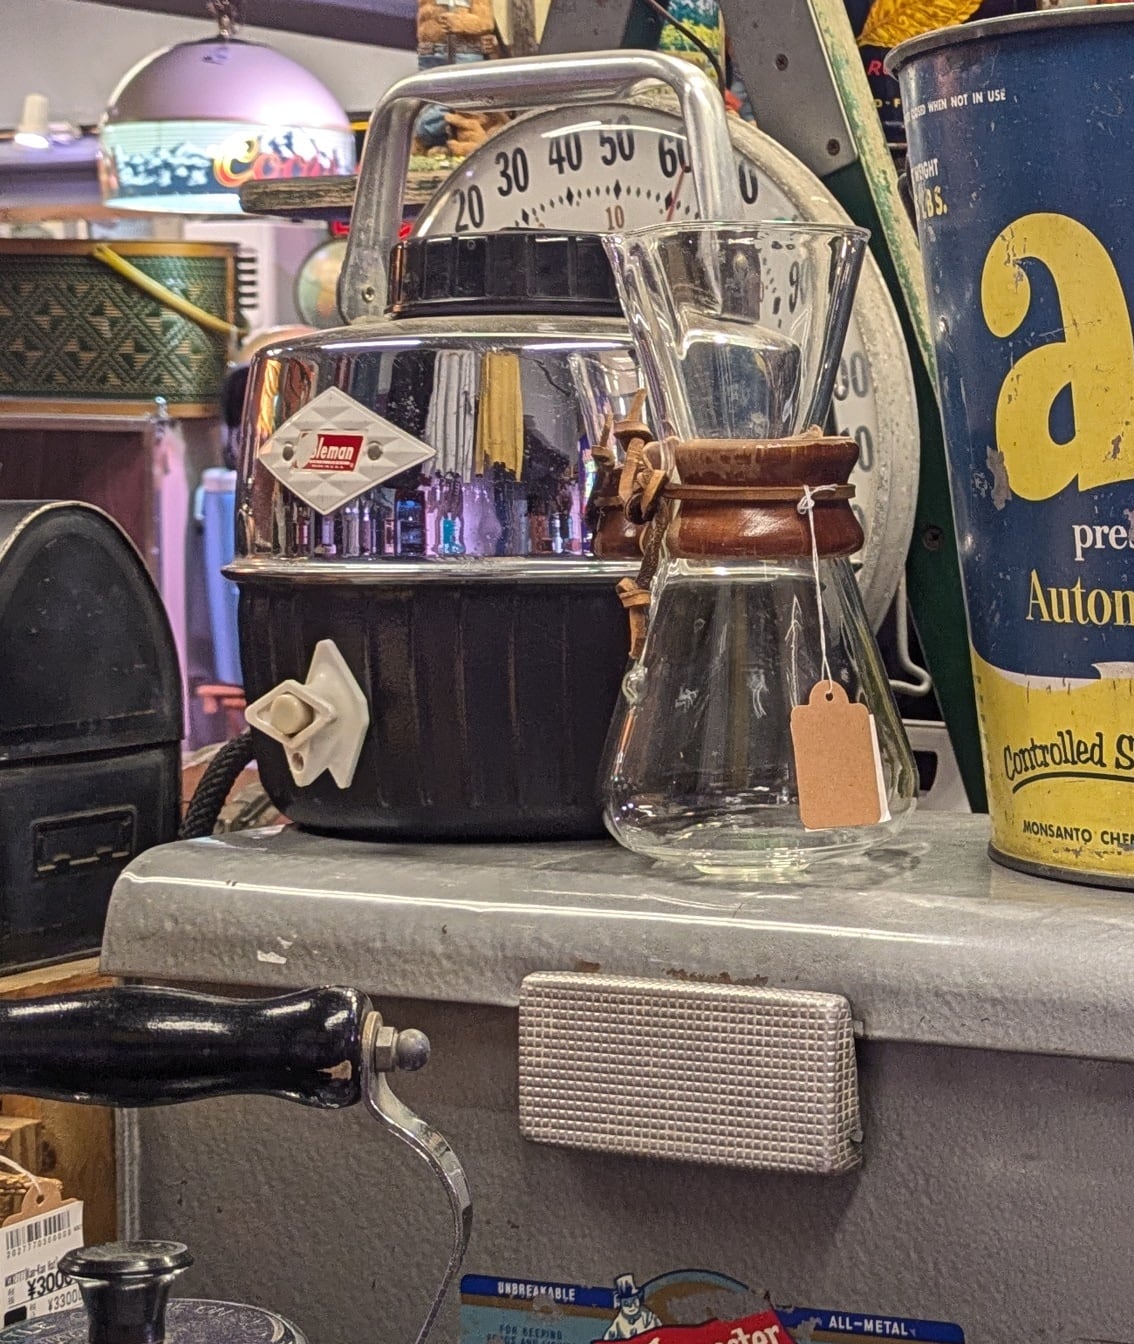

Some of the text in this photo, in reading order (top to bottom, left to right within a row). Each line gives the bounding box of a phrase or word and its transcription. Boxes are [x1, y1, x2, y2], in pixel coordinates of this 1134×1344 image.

[928, 98, 947, 113] WHEN
[951, 94, 968, 108] NOT
[972, 91, 983, 104] IN
[986, 88, 1006, 102] USE
[453, 184, 484, 232] 20
[495, 147, 529, 197] 30
[549, 130, 583, 175] 40
[600, 114, 635, 167] 50
[605, 205, 625, 231] 10
[1004, 729, 1107, 782] Controlled
[1023, 819, 1093, 844] MONSANTO
[500, 1324, 518, 1335] FOR
[828, 1314, 908, 1336] ALL-METAL
